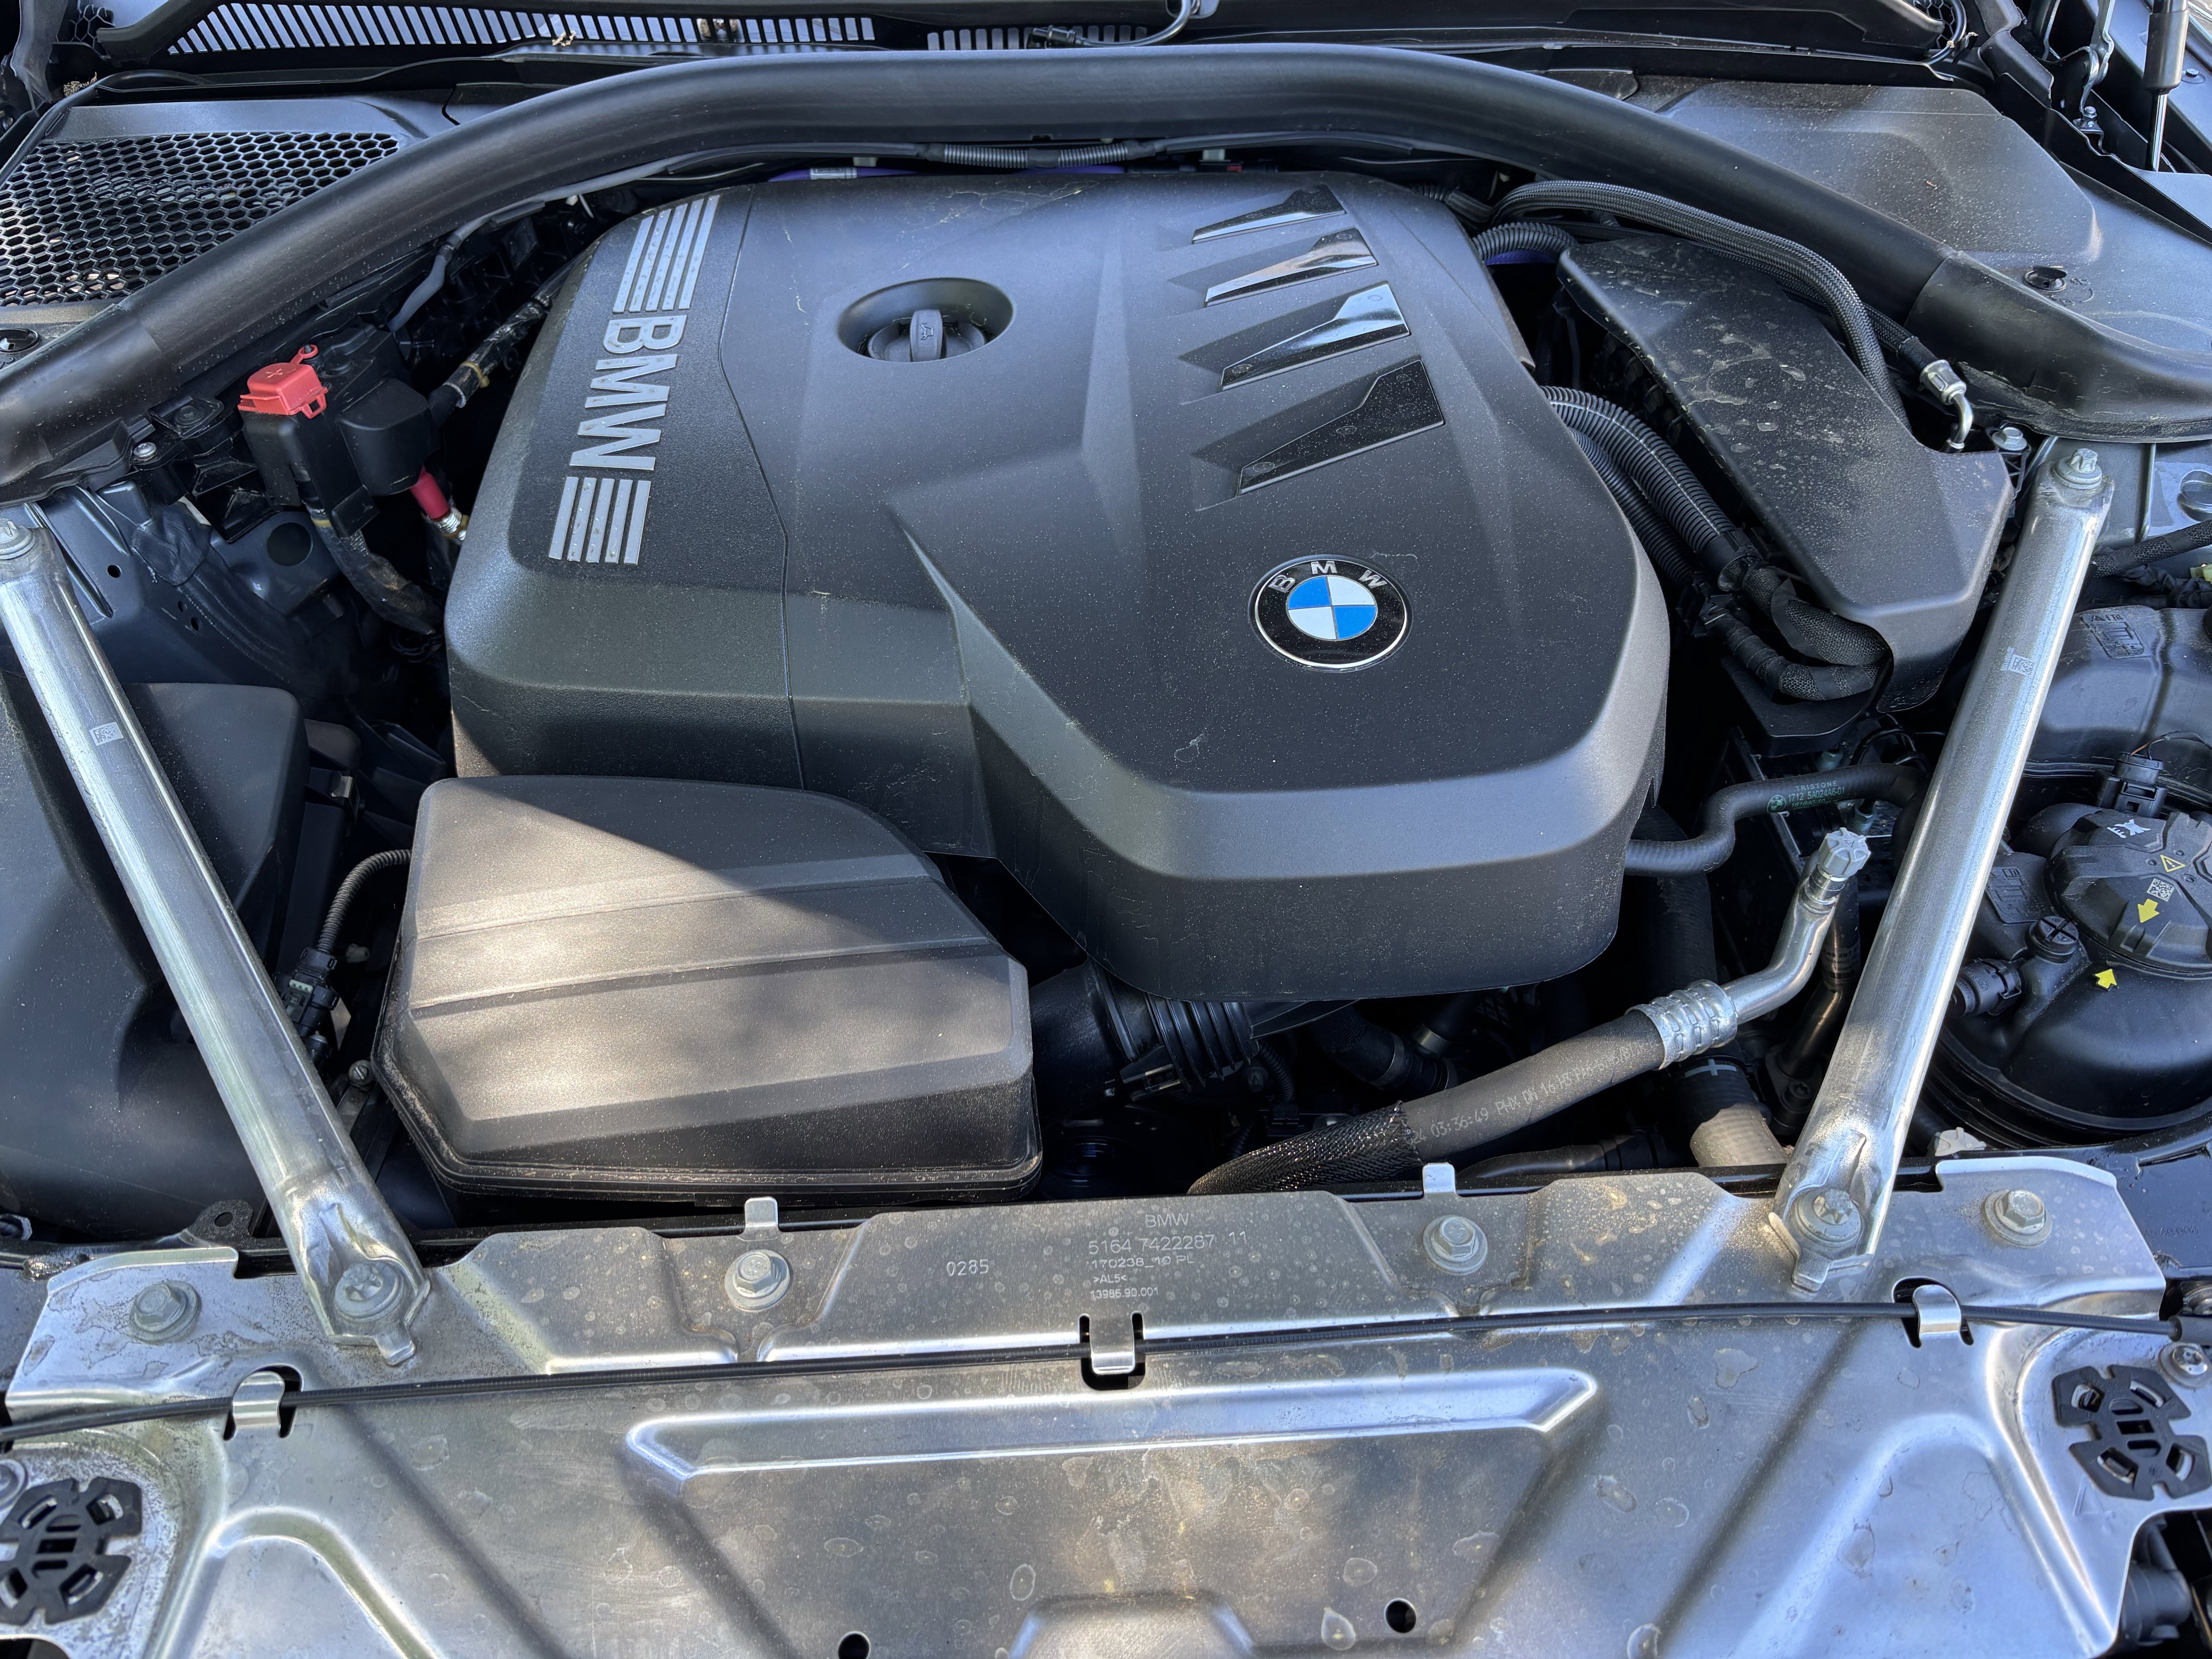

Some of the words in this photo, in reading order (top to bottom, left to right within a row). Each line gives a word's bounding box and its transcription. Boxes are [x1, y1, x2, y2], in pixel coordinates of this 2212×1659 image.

[569, 315, 687, 471] BMW
[1268, 560, 1388, 594] BMW
[1795, 781, 1838, 792] TRISTONE
[1788, 793, 1804, 802] 1712
[1431, 1108, 1489, 1137] 03:36:49
[1145, 1213, 1189, 1228] BMW
[1088, 1239, 1132, 1255] 5164
[1139, 1234, 1215, 1251] 7422287
[1228, 1231, 1247, 1245] 11
[1176, 1254, 1195, 1264] PL
[946, 1259, 989, 1276] 0285
[1093, 1274, 1127, 1284] >AL5<
[1090, 1287, 1159, 1299] 13986.90.001
